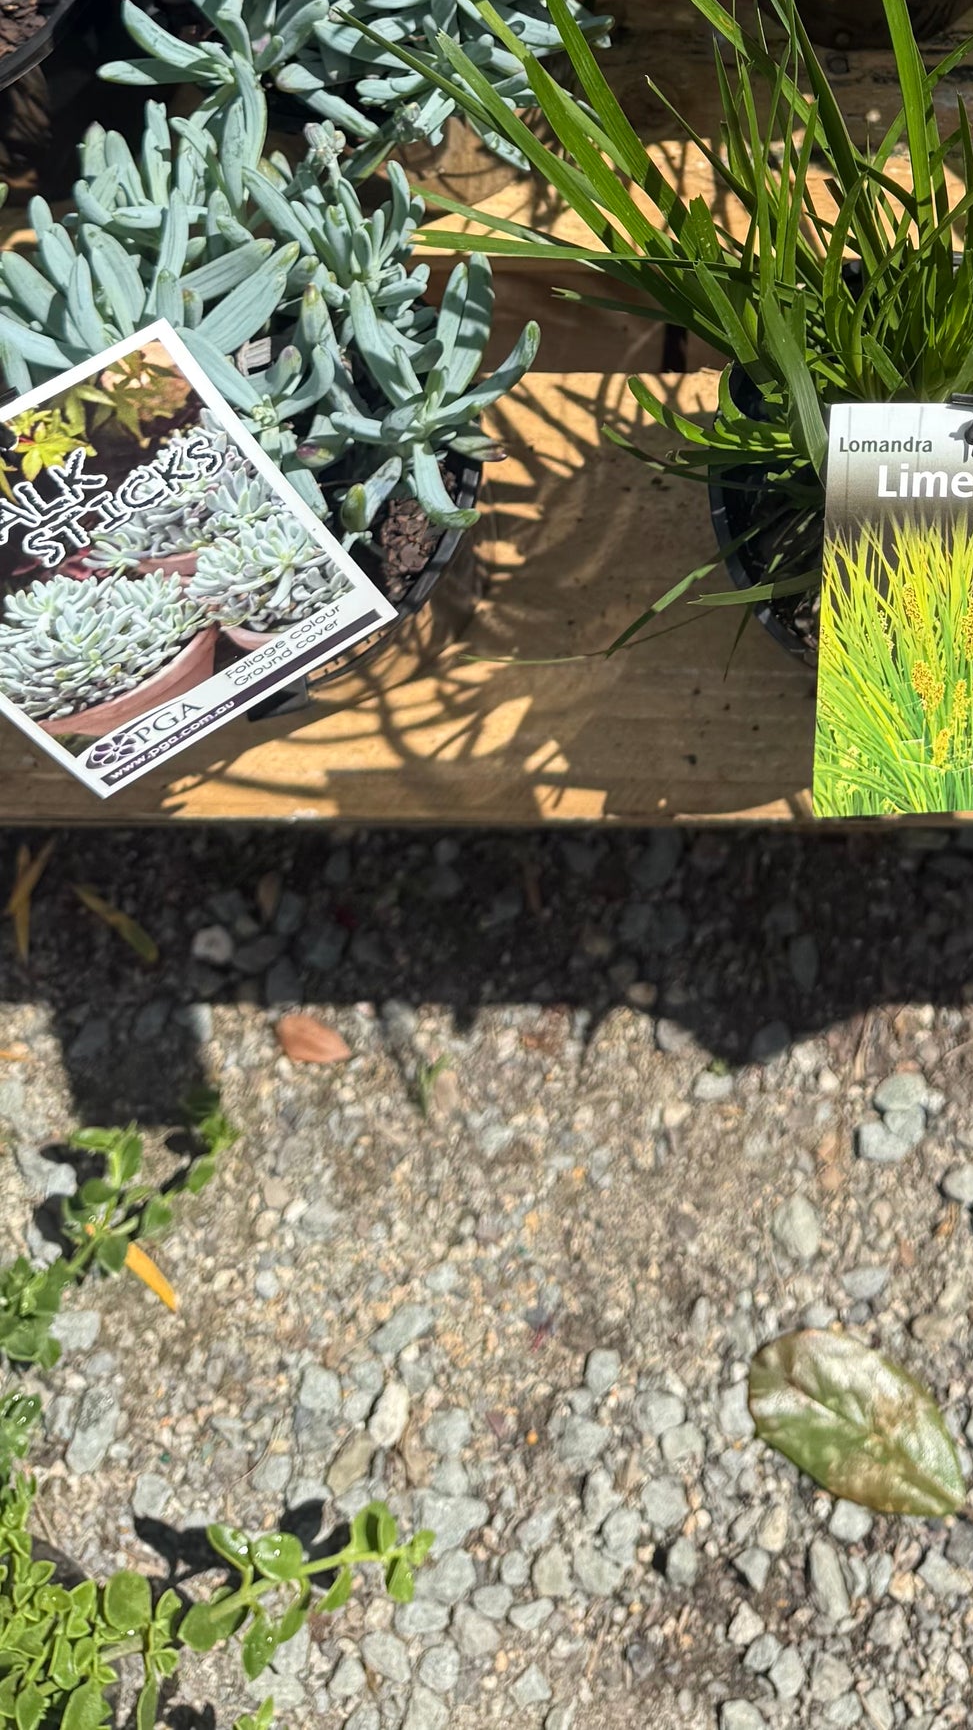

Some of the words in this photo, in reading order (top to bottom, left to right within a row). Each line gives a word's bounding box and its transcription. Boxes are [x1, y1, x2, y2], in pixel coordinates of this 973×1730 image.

[839, 436, 933, 453] Lomandra
[22, 436, 224, 568] STICKS
[224, 639, 286, 681] Foliage
[290, 604, 341, 641] colour
[233, 648, 294, 687] Ground
[296, 618, 339, 650] cover
[110, 700, 236, 781] www.pga.com.au
[135, 700, 204, 744] PGA
